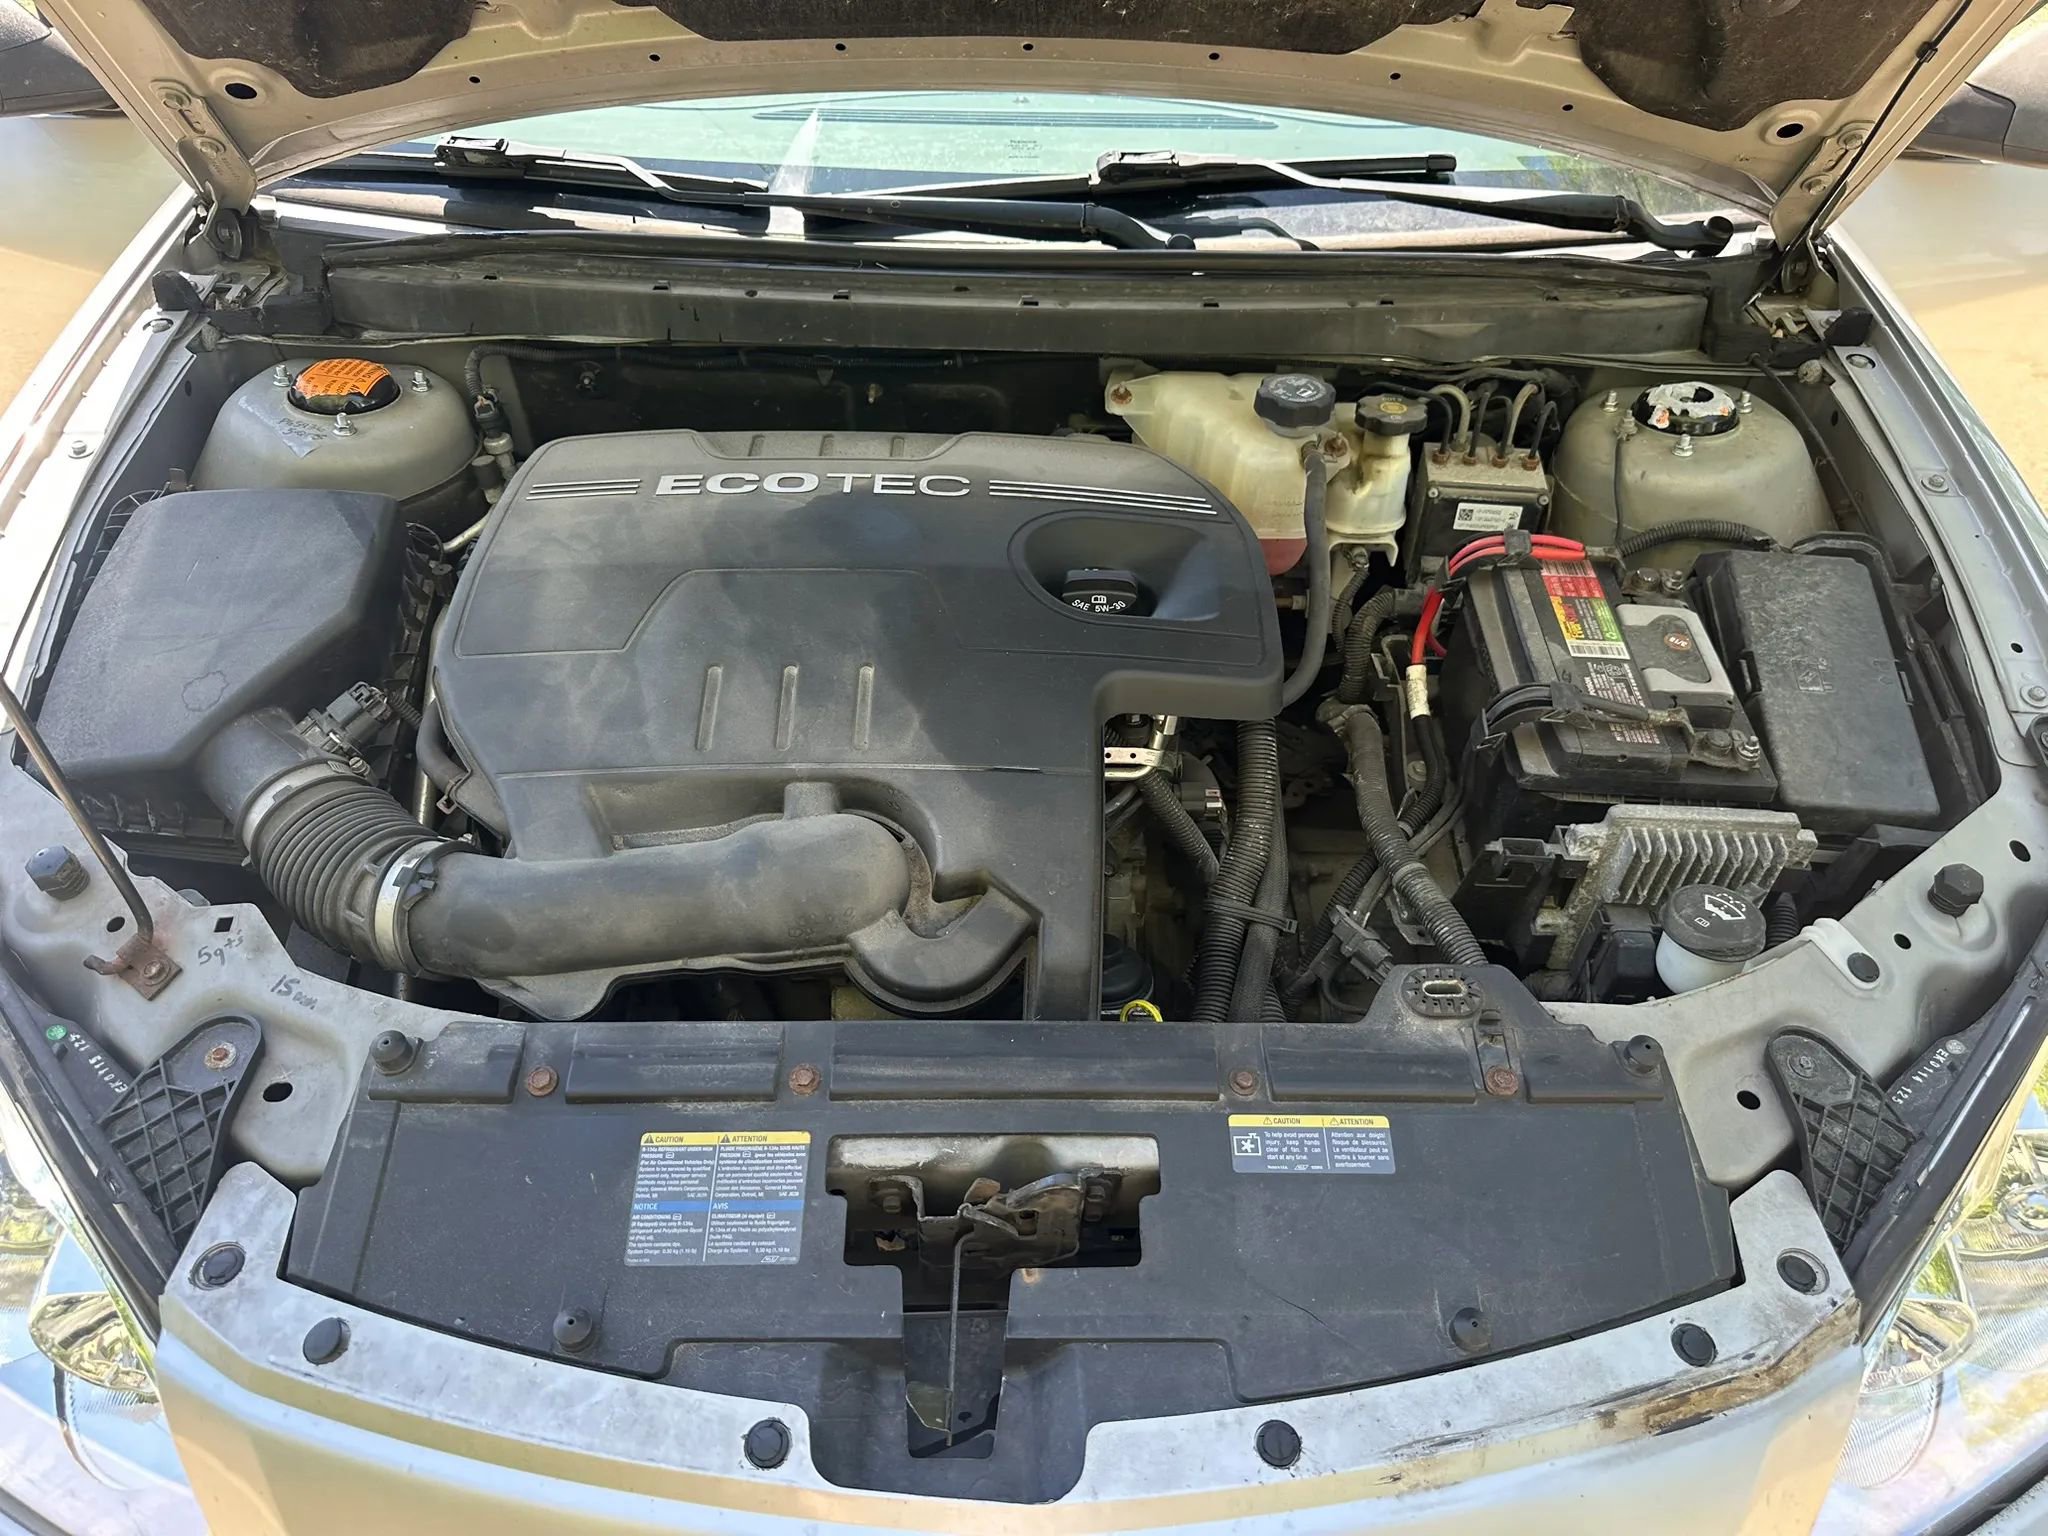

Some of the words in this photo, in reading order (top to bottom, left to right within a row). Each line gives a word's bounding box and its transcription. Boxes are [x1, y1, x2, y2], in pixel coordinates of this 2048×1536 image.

[655, 472, 971, 496] ECOTEC
[1071, 599, 1091, 611] SAE
[1095, 600, 1126, 613] 5W-30
[1911, 1048, 1950, 1083] EK0114
[88, 1055, 129, 1094] EK0115
[1891, 1086, 1912, 1104] 125
[1273, 1117, 1301, 1125] CAUTION
[1340, 1118, 1374, 1126] ATTENTION
[1271, 1131, 1283, 1139] help
[712, 1202, 729, 1210] AVIS
